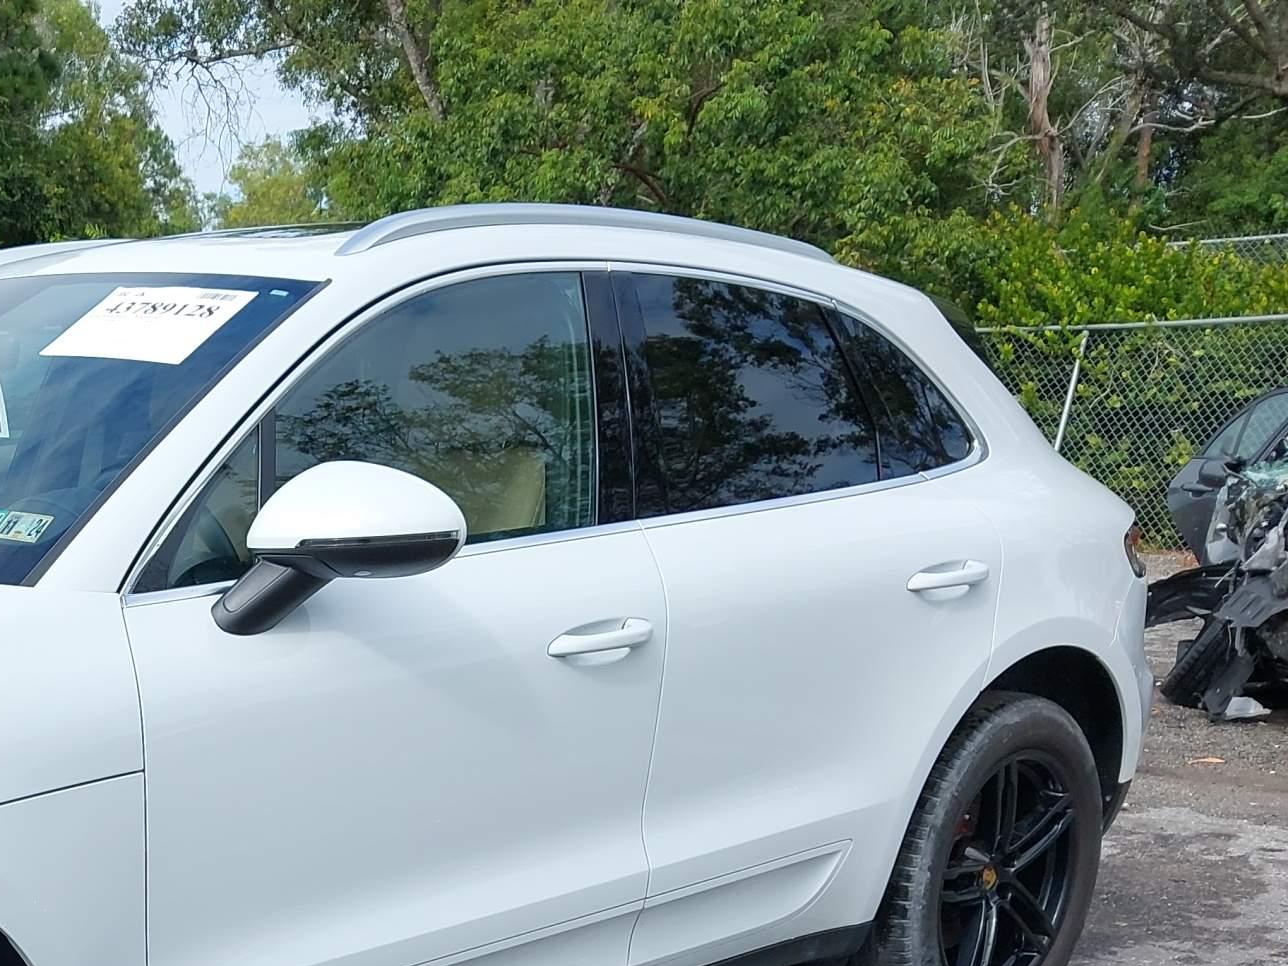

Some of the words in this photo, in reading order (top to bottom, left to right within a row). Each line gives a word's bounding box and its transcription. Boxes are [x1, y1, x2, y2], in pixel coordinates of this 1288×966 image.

[105, 302, 221, 319] 43789128
[0, 519, 19, 535] 11
[27, 518, 49, 538] 24
